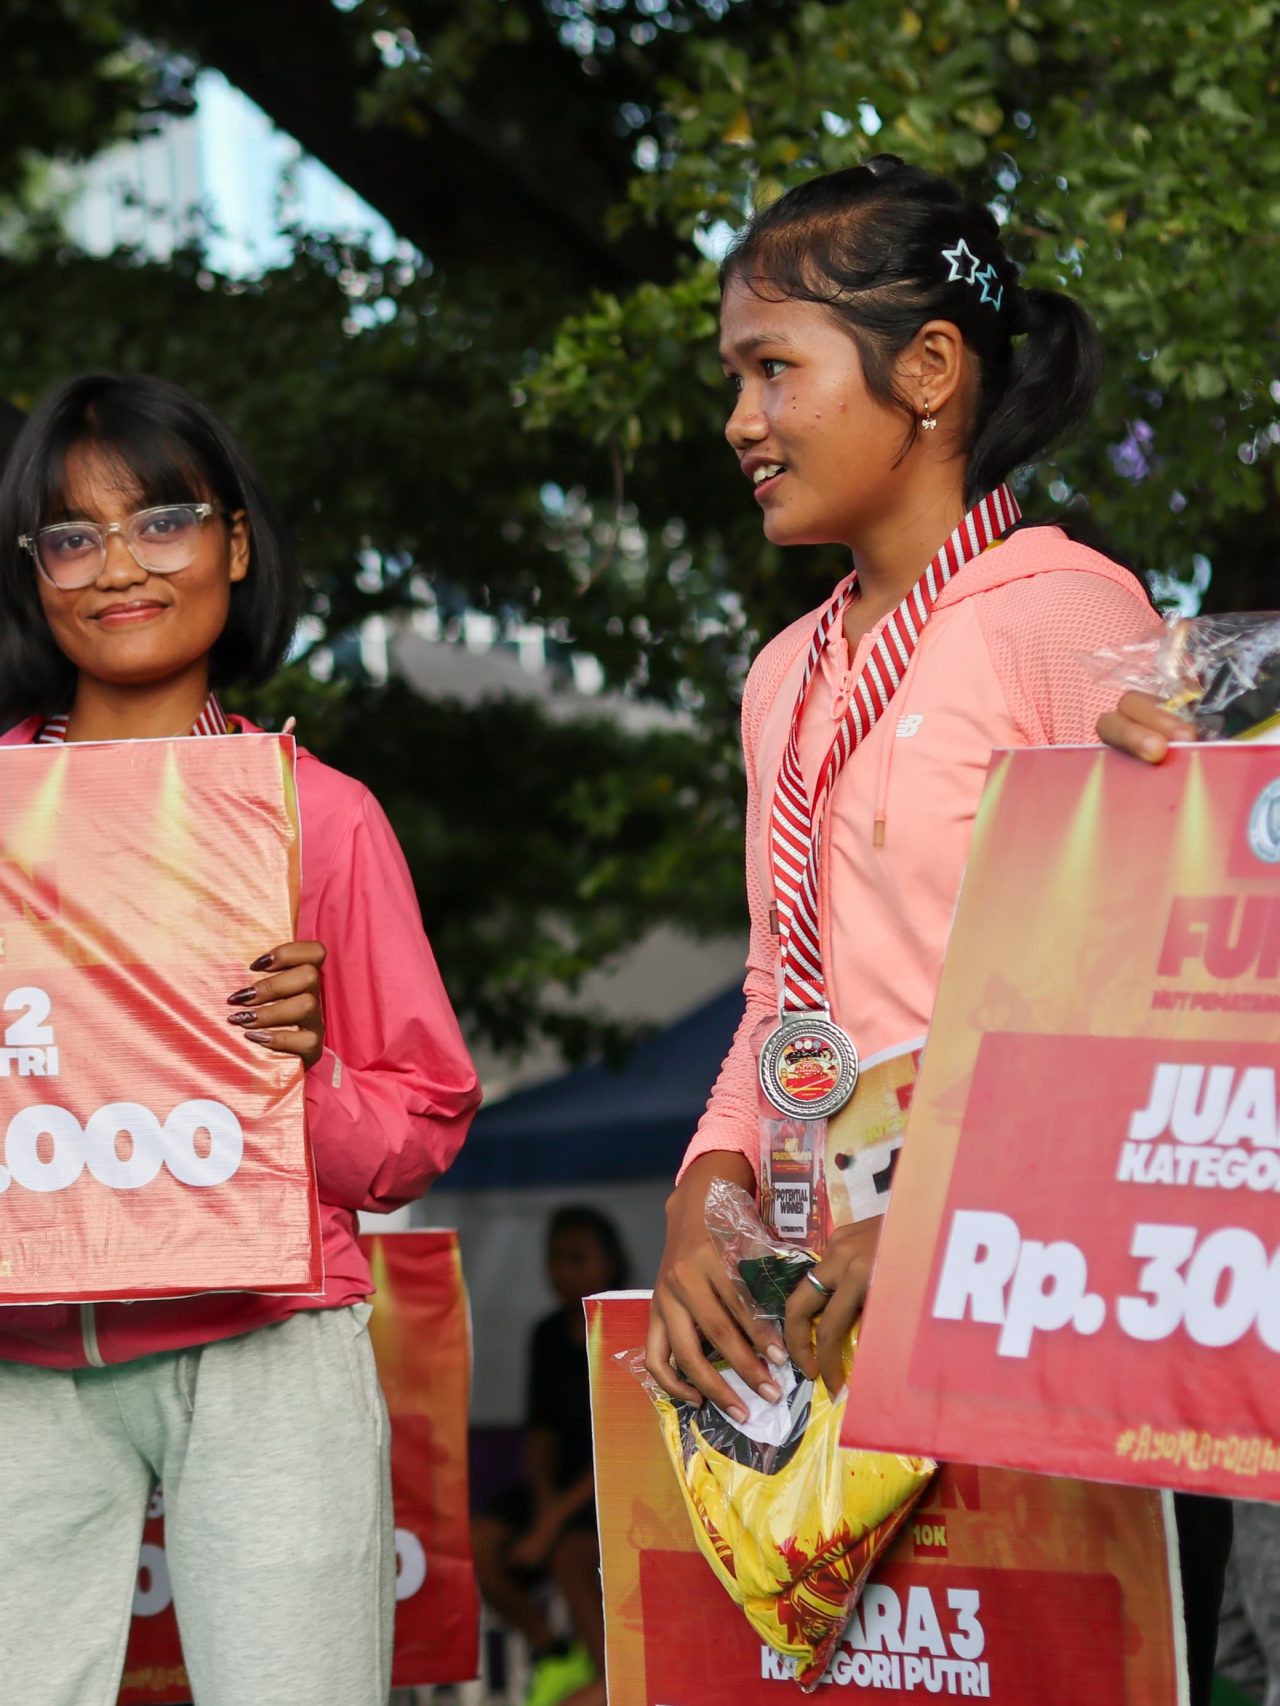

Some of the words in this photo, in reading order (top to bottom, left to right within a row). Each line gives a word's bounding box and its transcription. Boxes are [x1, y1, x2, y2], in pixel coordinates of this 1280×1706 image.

[4, 987, 54, 1045] 2
[932, 1209, 1106, 1358] Rp.
[1116, 1223, 1280, 1354] 30
[947, 1588, 985, 1660] 3
[904, 1656, 990, 1698] PUTRI
